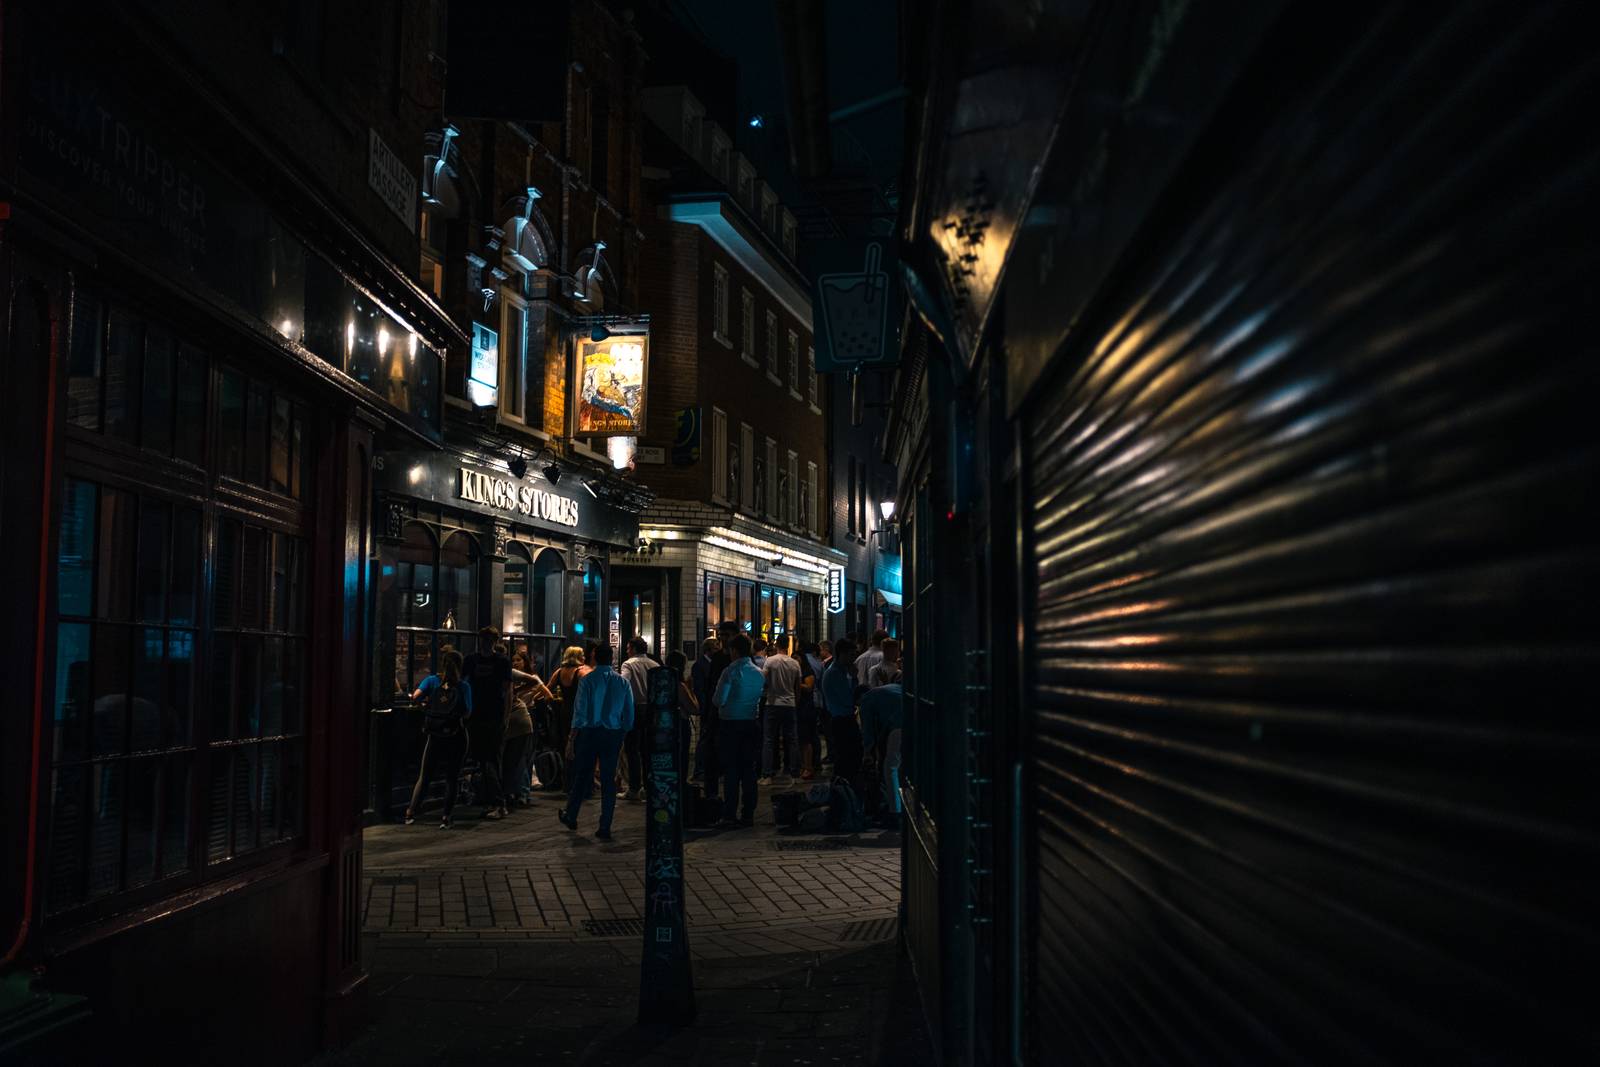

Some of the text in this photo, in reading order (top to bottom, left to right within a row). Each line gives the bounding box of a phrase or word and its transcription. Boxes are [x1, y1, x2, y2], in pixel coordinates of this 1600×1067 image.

[25, 115, 208, 255] DISCOVER YOUR UNIQUE
[460, 467, 579, 527] KINGS STORES
[830, 570, 840, 609] HONEST
